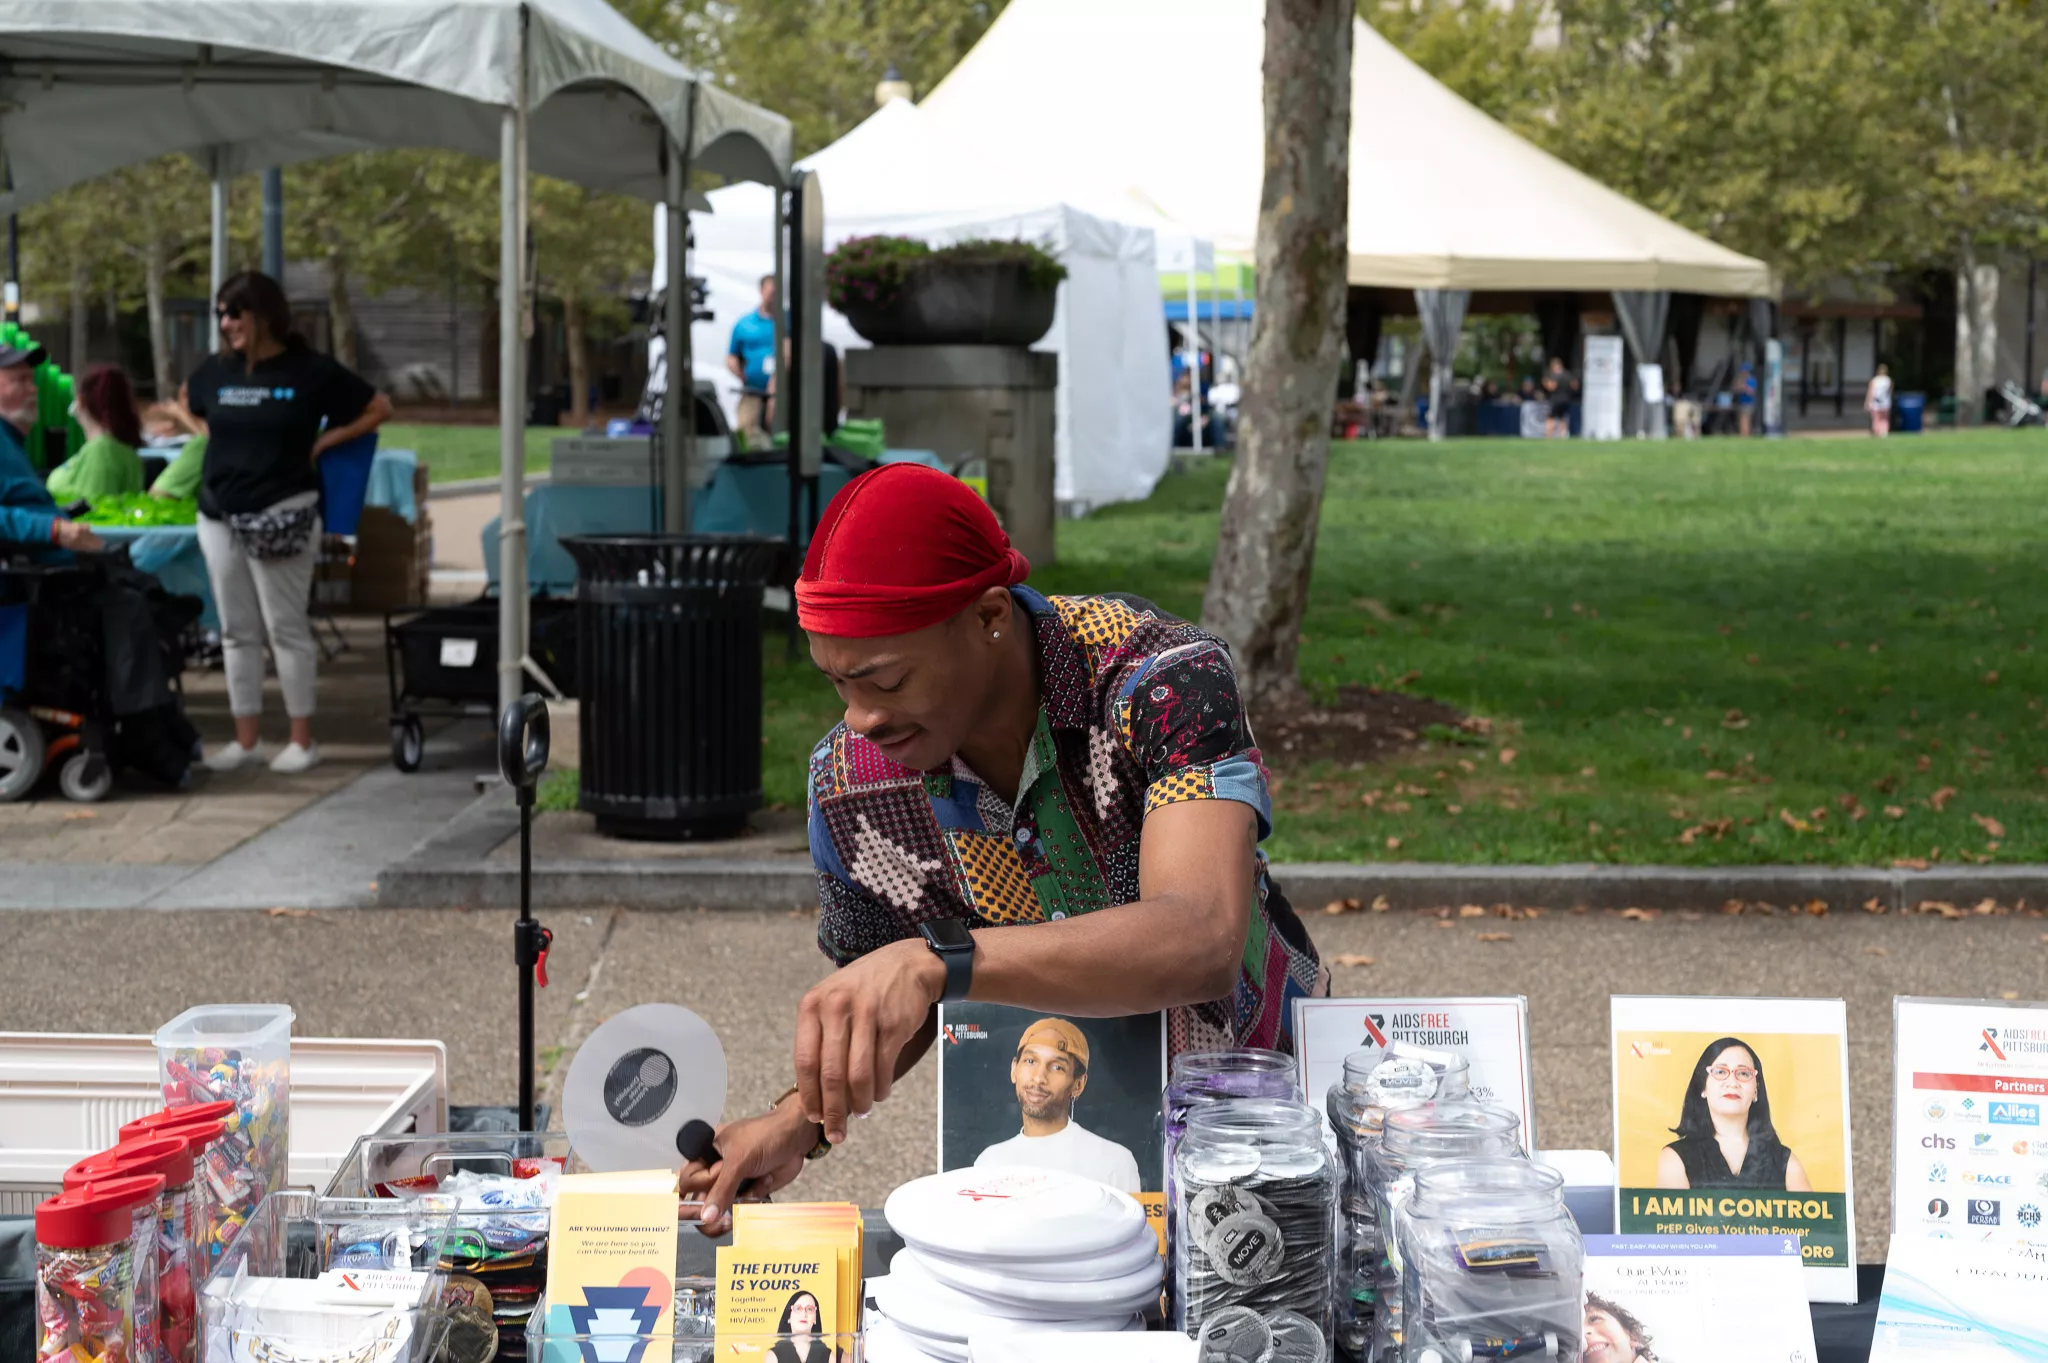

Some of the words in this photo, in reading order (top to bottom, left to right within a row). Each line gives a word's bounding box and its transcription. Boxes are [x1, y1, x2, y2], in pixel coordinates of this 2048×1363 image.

[1392, 1013, 1450, 1028] AIDSFREE
[1392, 1031, 1469, 1046] PITTSBURGH
[2003, 1028, 2047, 1041] AIDSFREE
[1995, 1080, 2045, 1092] Partners
[1472, 1087, 1494, 1098] 3%
[1921, 1133, 1956, 1149] chs
[1977, 1174, 2012, 1185] FACE
[1633, 1196, 1640, 1216] I
[1644, 1197, 1684, 1216] AM
[1689, 1197, 1714, 1217] IN
[1718, 1198, 1834, 1220] CONTROL
[1971, 1215, 1997, 1225] PERSAD
[2018, 1210, 2041, 1222] PCHS
[1656, 1223, 1682, 1234] PrEP
[1685, 1224, 1719, 1235] Gives
[1722, 1225, 1746, 1235] You
[1749, 1224, 1769, 1236] the
[1772, 1226, 1810, 1237] Power
[1234, 1235, 1260, 1265] MOVE
[1784, 1239, 1793, 1251] 2
[732, 1263, 760, 1275] THE
[763, 1263, 820, 1275] FUTURE
[730, 1280, 745, 1291] IS
[750, 1279, 801, 1291] YOURS
[731, 1296, 766, 1304] Together
